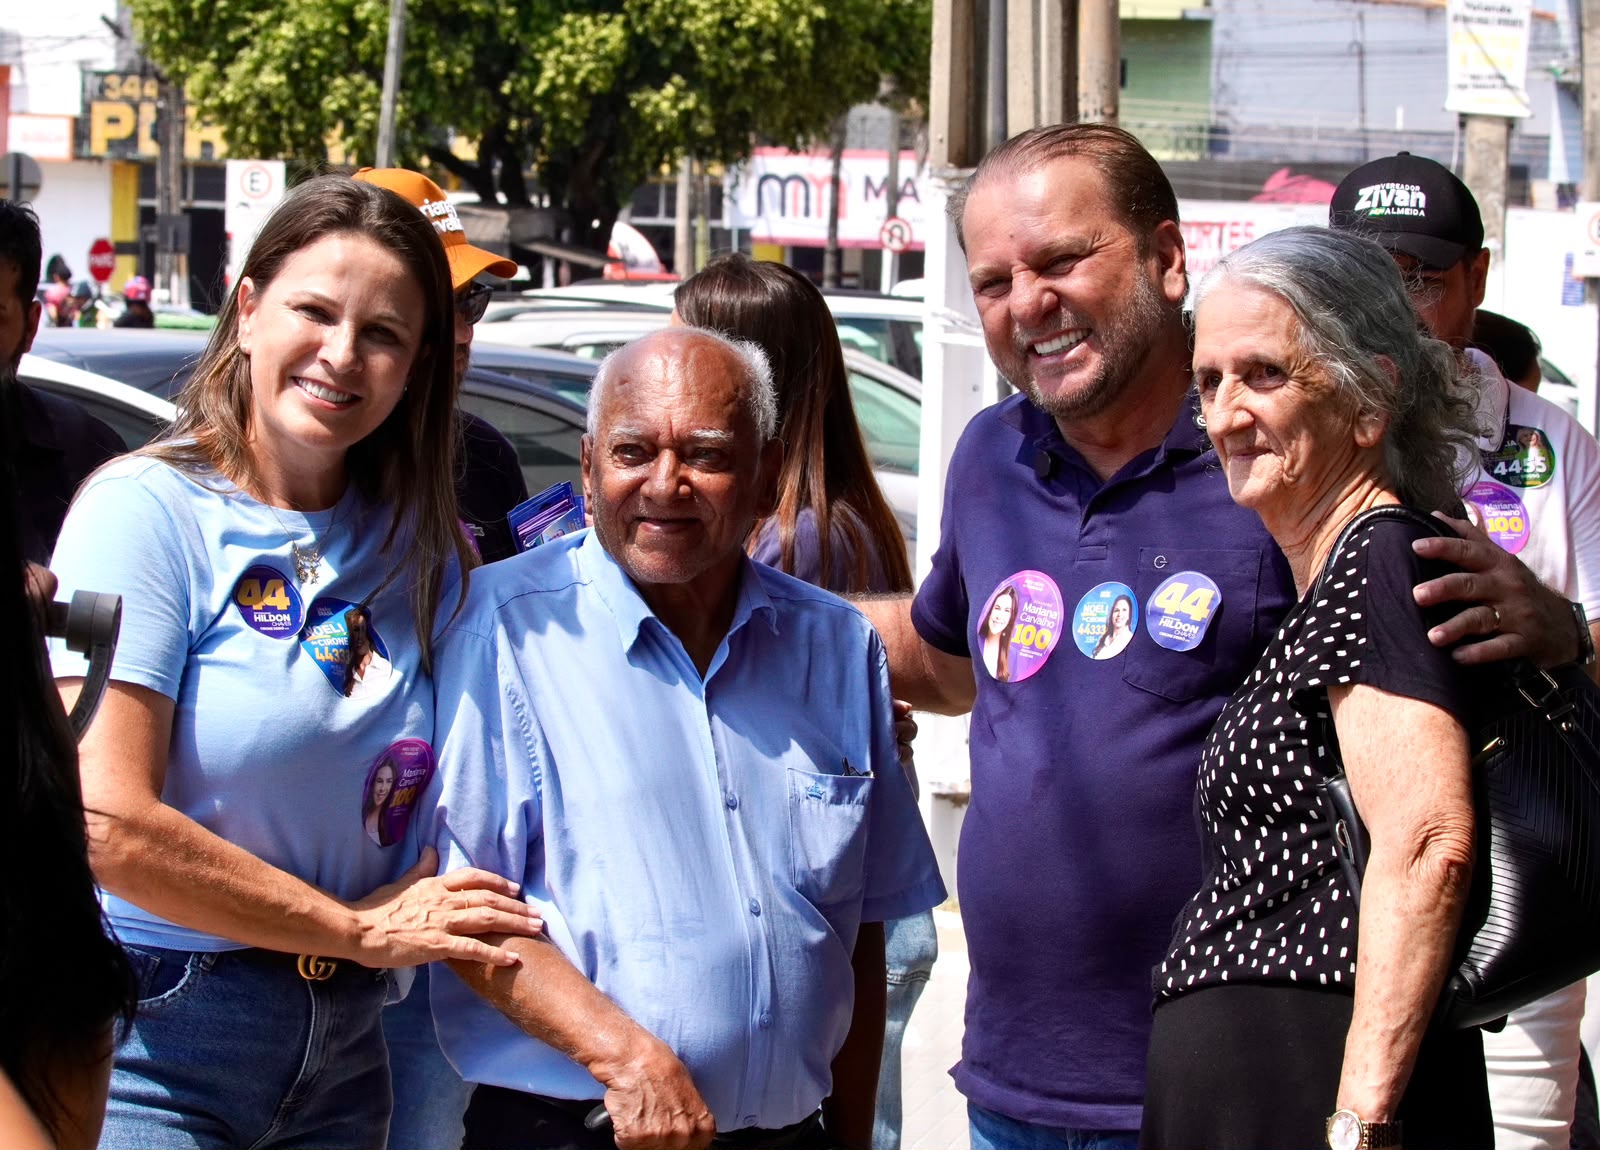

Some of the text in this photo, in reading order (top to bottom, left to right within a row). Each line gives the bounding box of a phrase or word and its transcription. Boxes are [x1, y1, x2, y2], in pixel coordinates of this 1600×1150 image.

[1384, 207, 1426, 217] ALMEIDA
[1493, 456, 1548, 476] 4455
[1487, 516, 1524, 533] 100
[237, 578, 291, 611] 44
[1153, 582, 1216, 622] 44
[253, 613, 291, 622] HILDON
[1022, 601, 1058, 620] Mariana
[1019, 611, 1055, 629] Carvalho
[1158, 616, 1200, 634] HILDON
[1010, 623, 1052, 649] 100
